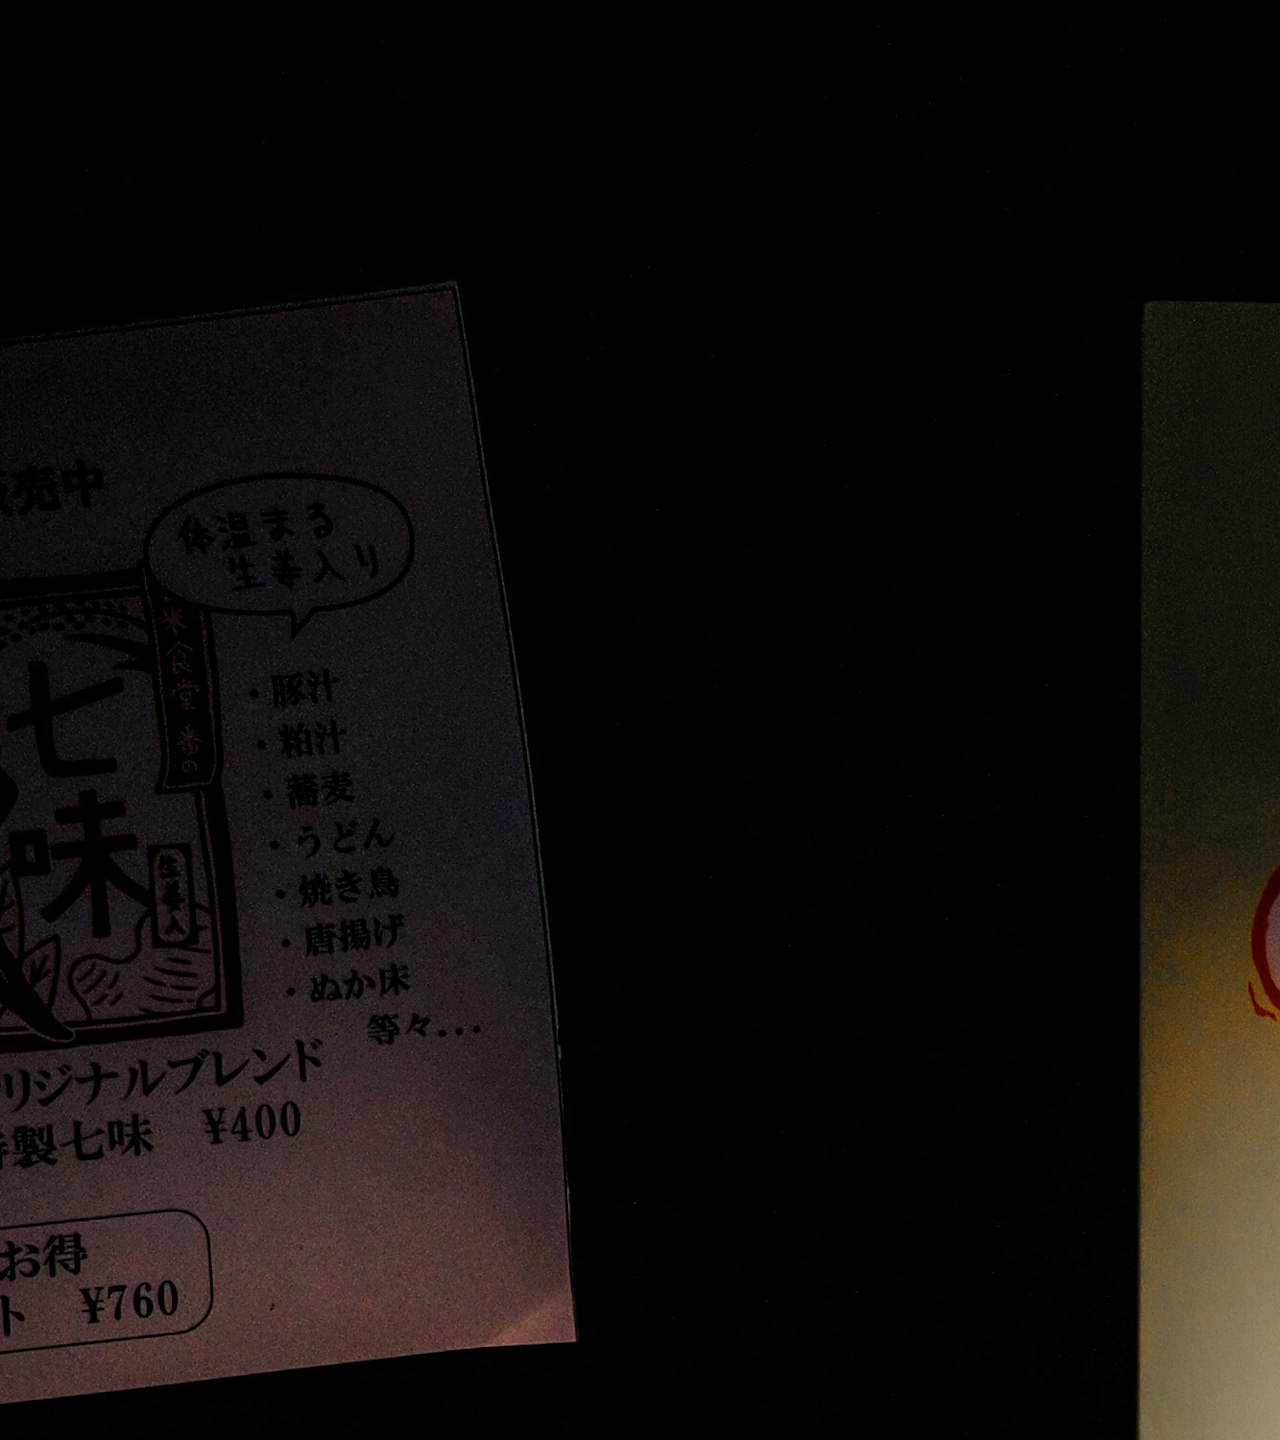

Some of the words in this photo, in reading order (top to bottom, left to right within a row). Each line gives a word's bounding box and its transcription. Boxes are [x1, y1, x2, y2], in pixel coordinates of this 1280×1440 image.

[271, 666, 340, 708] 豚汁
[298, 817, 395, 856] うどん
[299, 865, 400, 908] 焼き鳥
[304, 912, 405, 957] 唐揚げ
[309, 963, 411, 1004] ぬか床
[0, 1113, 153, 1169] 製七味
[203, 1100, 301, 1145] ¥400
[79, 1279, 179, 1325] ¥760
